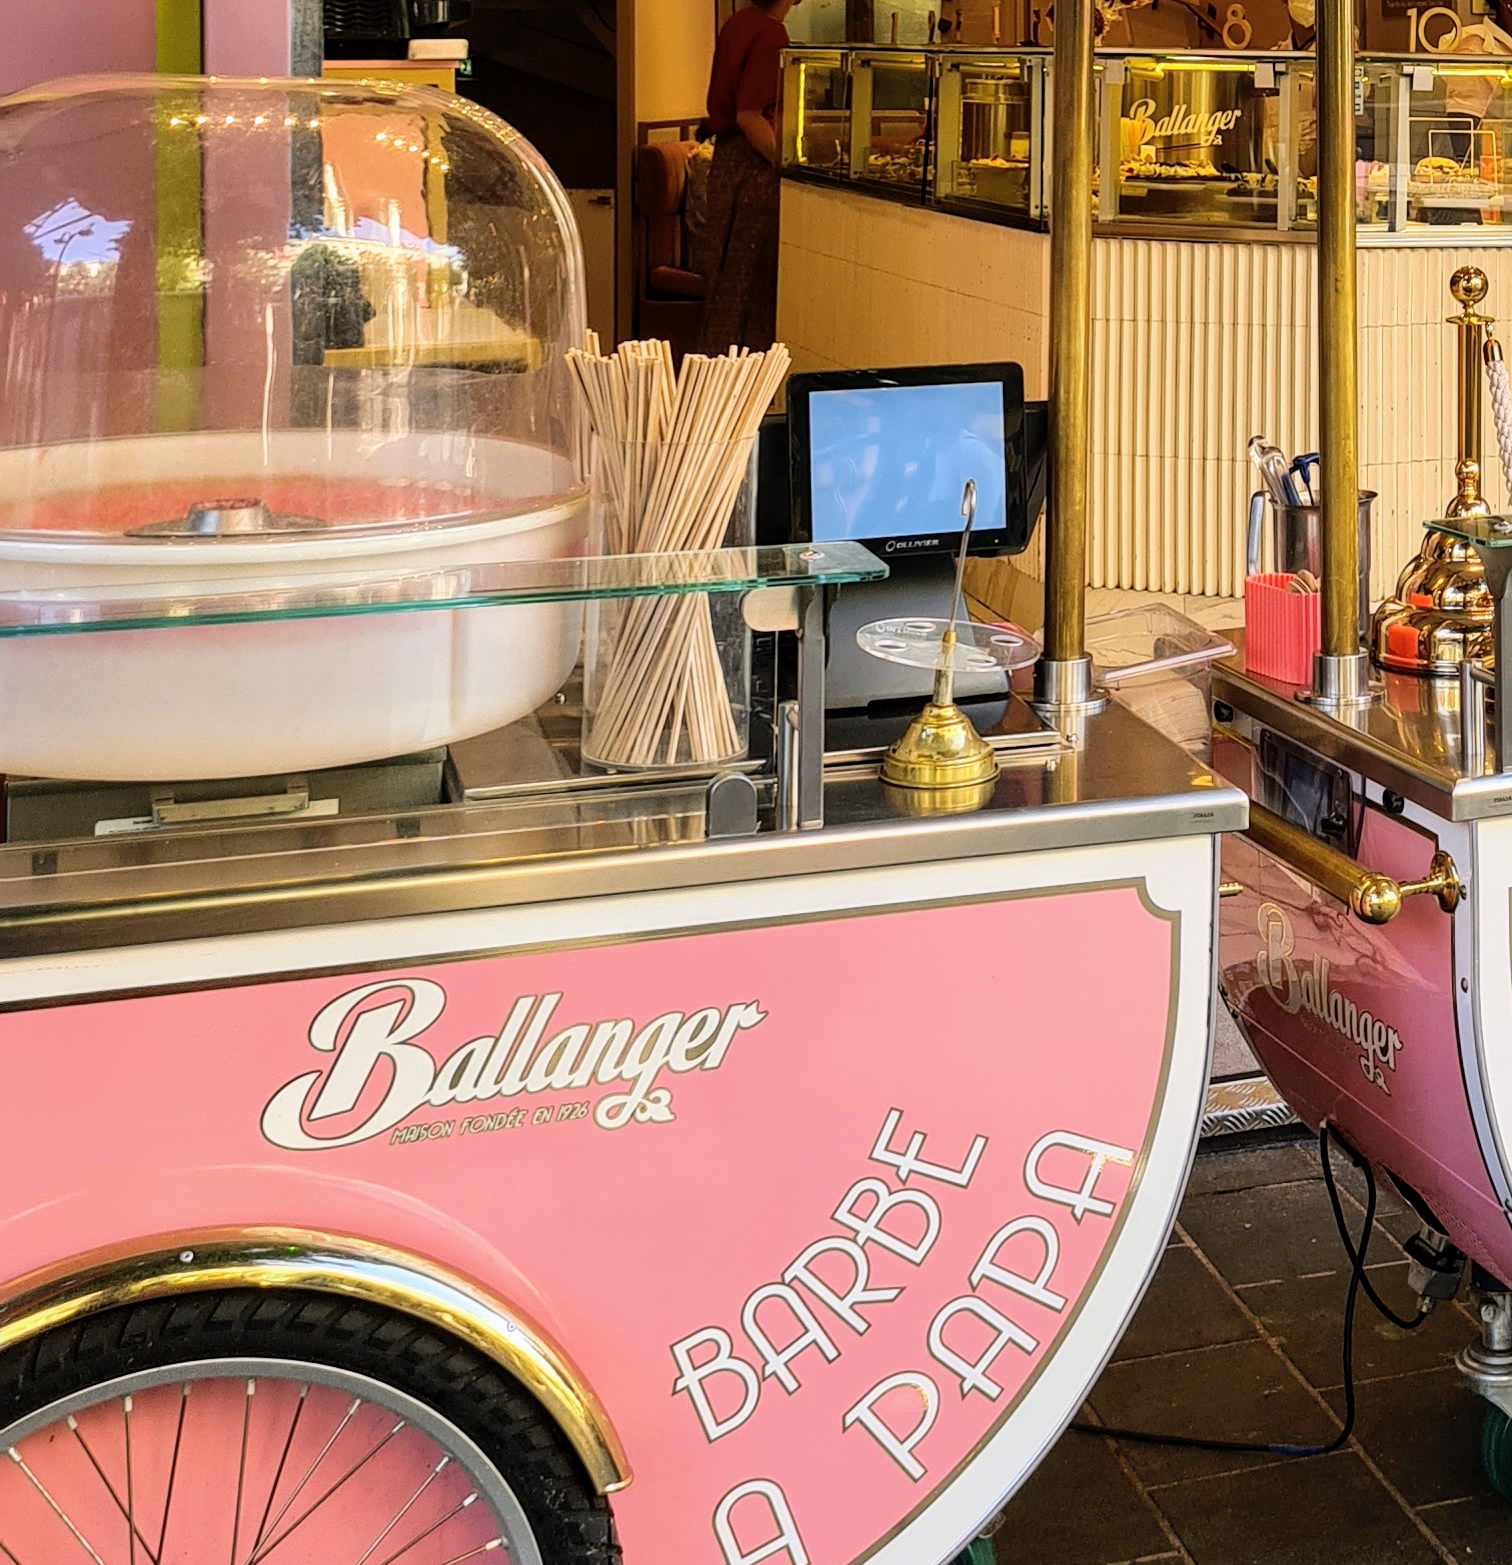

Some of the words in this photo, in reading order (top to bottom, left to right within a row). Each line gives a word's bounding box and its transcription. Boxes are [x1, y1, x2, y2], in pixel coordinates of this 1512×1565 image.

[1223, 3, 1252, 50] 8
[1407, 6, 1463, 53] 10
[1129, 98, 1242, 147] Ballanger
[1257, 902, 1403, 1096] Ballanger
[261, 977, 767, 1152] Ballanger
[390, 1119, 453, 1145] MAISON
[459, 1108, 528, 1136] FONDÉE
[531, 1106, 555, 1126] EN
[555, 1101, 591, 1122] 1926
[673, 1107, 990, 1443] BARBE
[842, 1129, 1136, 1483] PAPA
